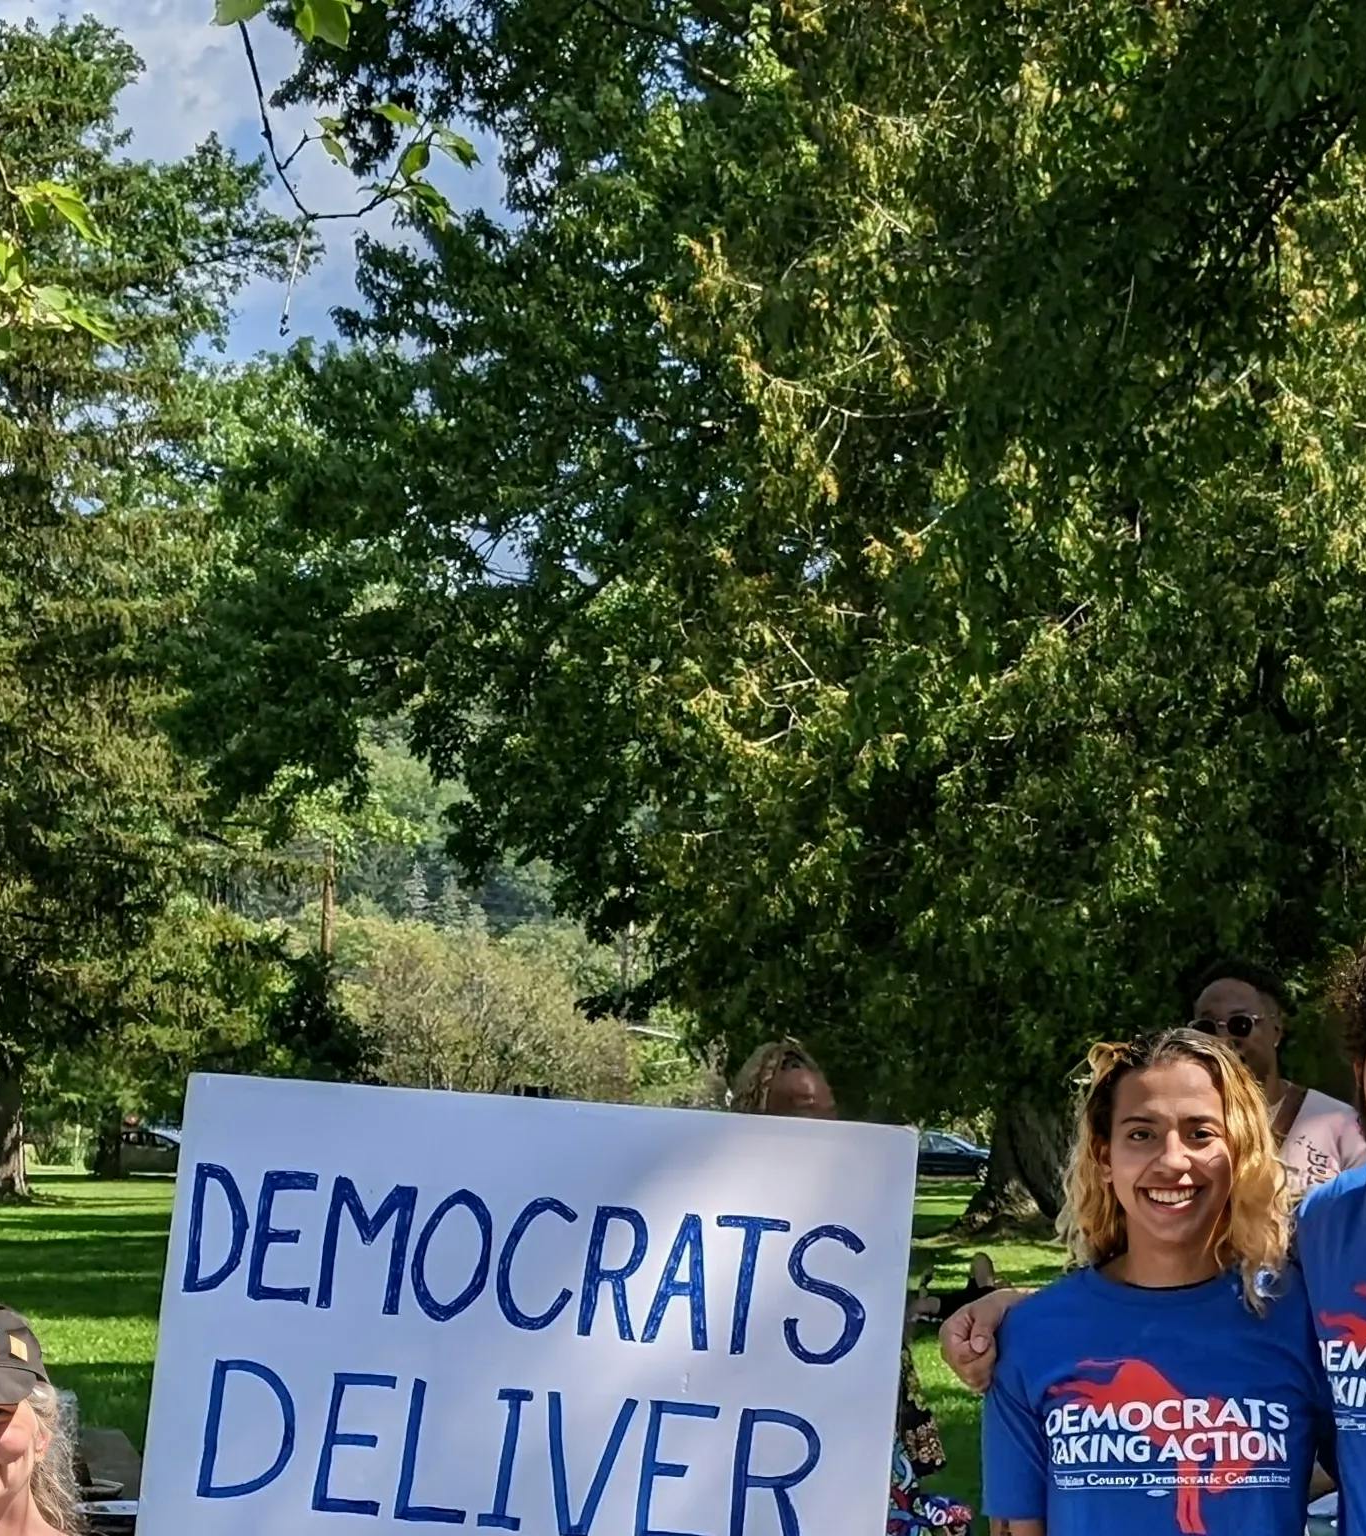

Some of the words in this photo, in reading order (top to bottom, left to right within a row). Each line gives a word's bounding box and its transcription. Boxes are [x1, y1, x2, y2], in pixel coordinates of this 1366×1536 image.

[183, 1162, 866, 1364] DEMOCRATS
[1045, 1398, 1290, 1437] DEMOCRATS
[1157, 1431, 1287, 1462] ACTION
[1087, 1474, 1138, 1489] County
[1142, 1473, 1221, 1485] Democratic
